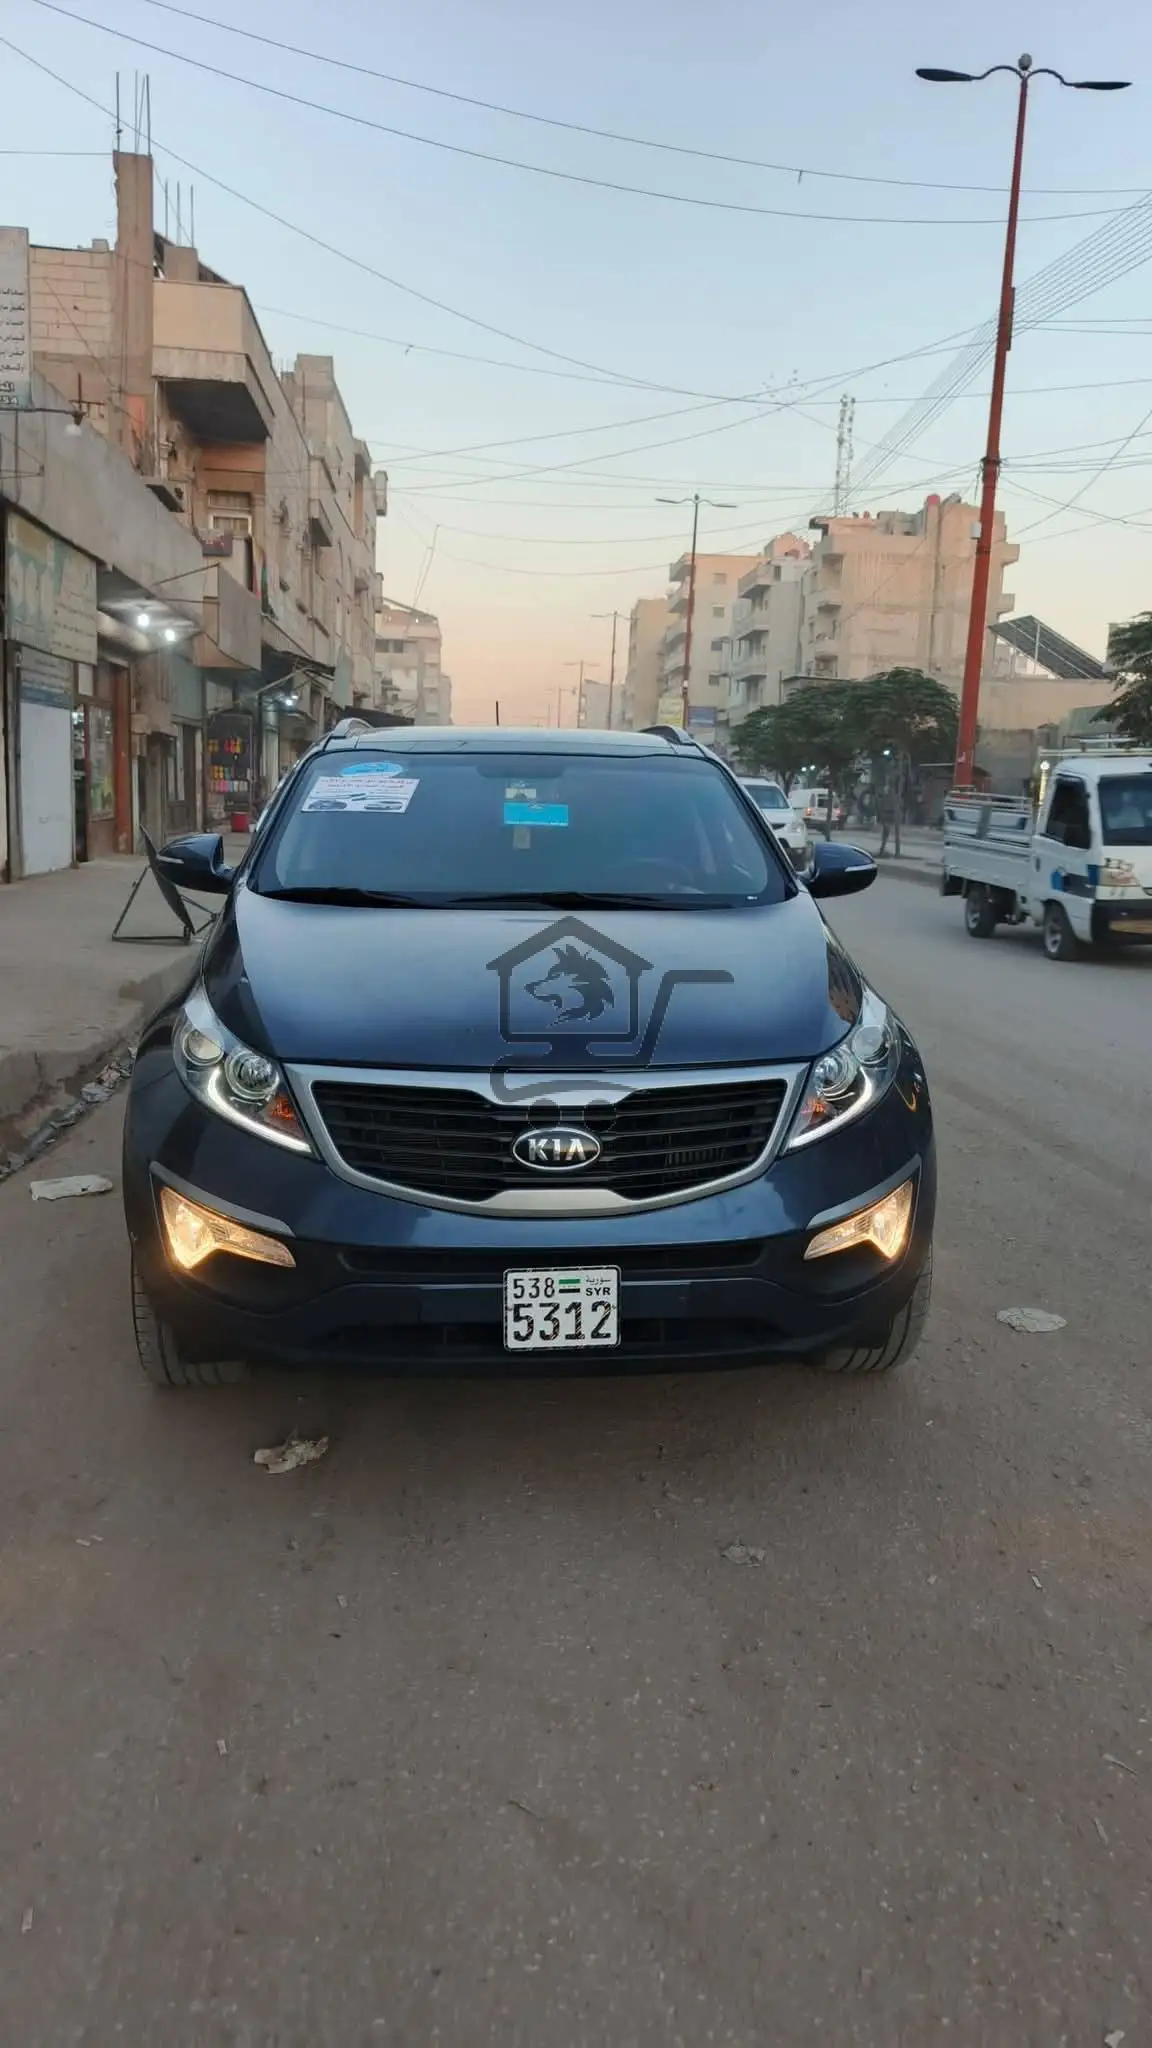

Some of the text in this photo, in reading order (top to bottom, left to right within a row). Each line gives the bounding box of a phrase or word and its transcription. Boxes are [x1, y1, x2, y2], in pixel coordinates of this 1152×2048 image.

[527, 1138, 587, 1161] KIA
[513, 1277, 556, 1299] 538
[585, 1287, 611, 1296] SYR
[513, 1300, 613, 1342] 5312
